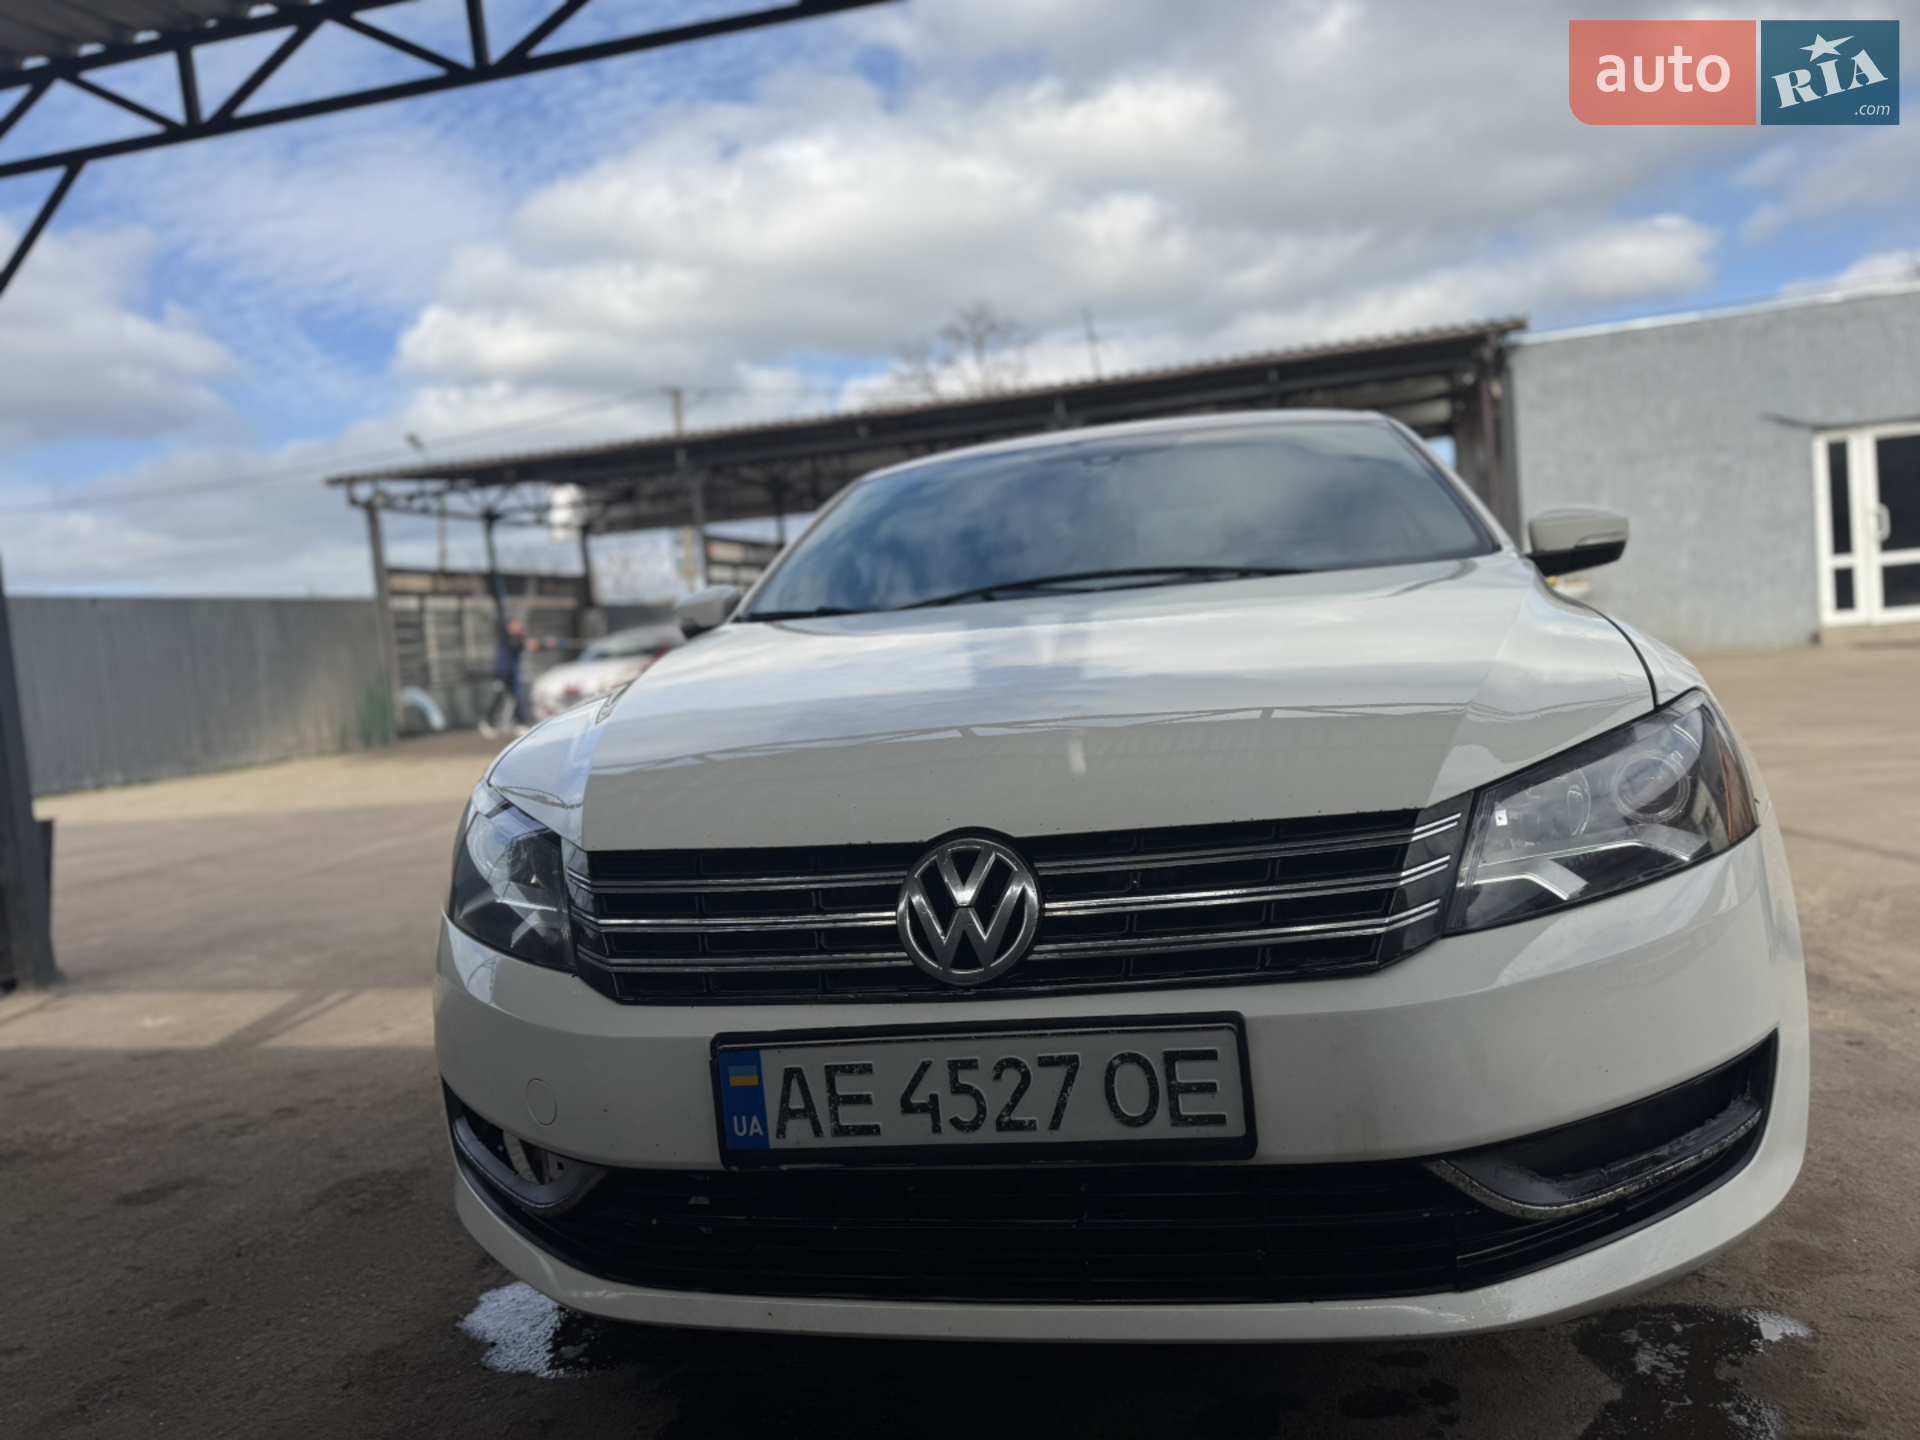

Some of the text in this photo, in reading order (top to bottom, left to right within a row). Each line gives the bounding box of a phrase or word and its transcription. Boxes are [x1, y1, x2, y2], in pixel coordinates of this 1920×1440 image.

[775, 1047, 1228, 1139] AE 4527 OE
[733, 1115, 764, 1137] UA
